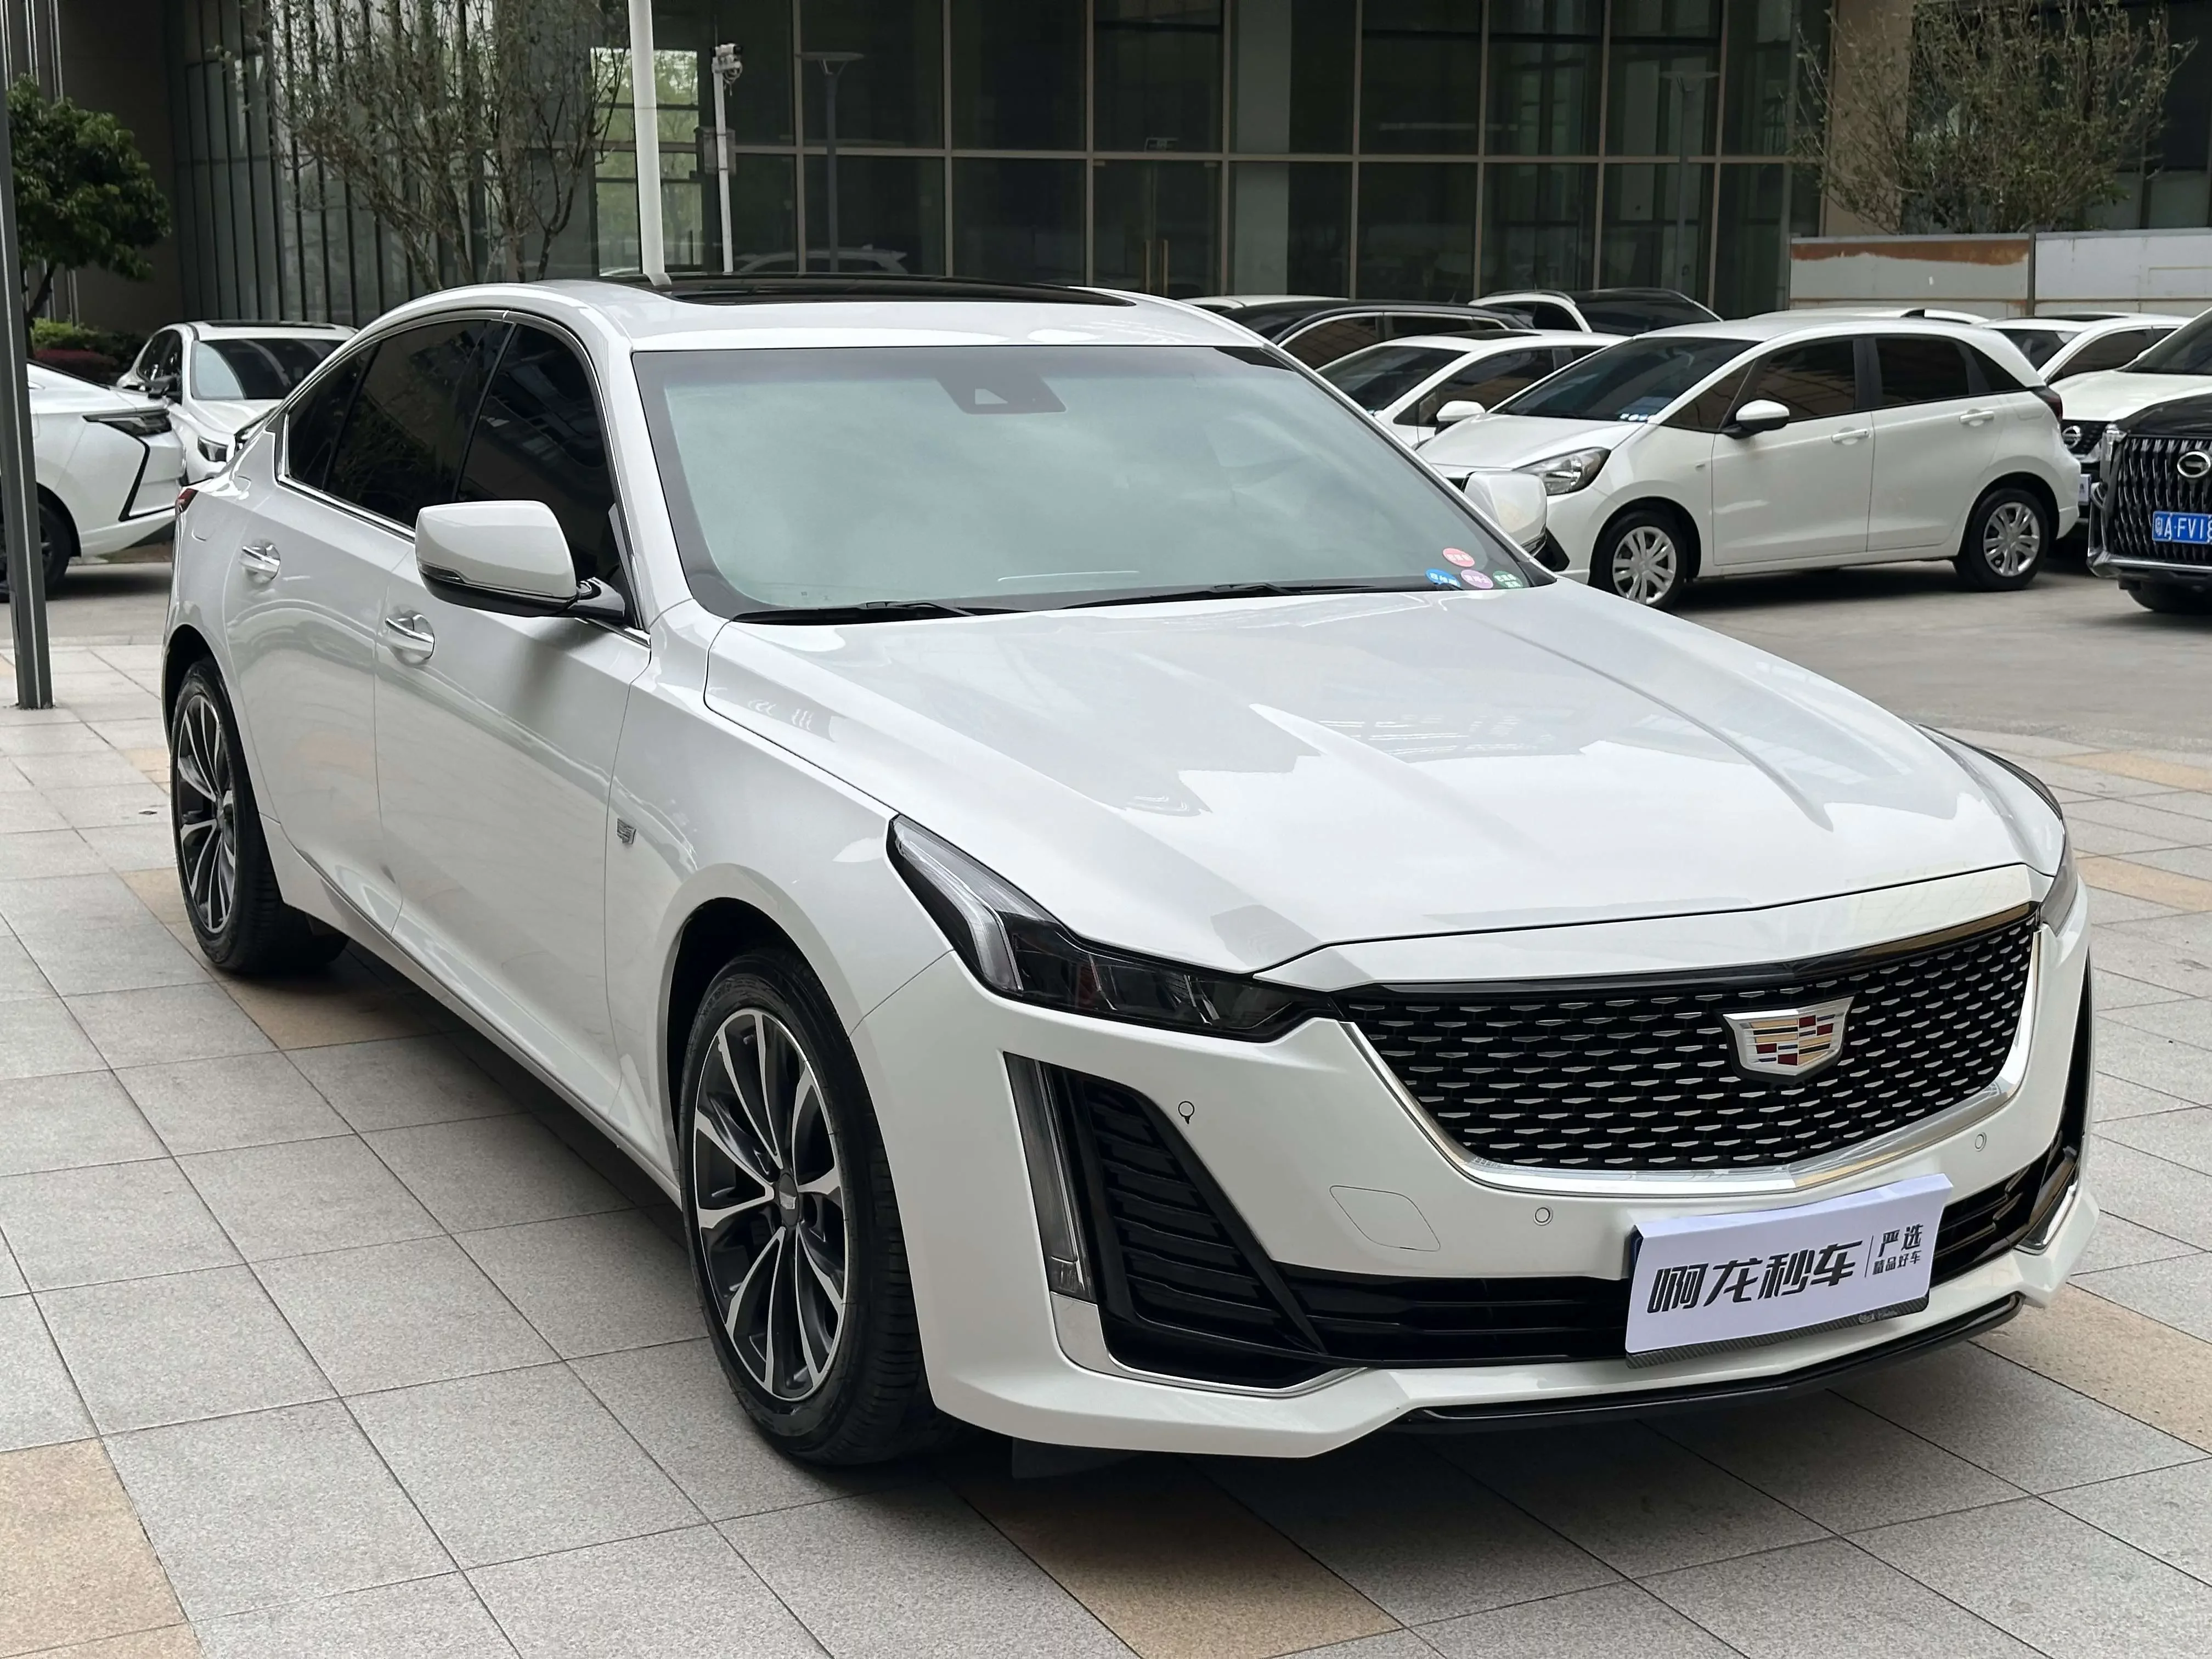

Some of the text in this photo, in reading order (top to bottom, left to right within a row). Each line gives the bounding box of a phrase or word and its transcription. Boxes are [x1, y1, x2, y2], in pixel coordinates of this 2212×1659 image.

[1878, 1224, 1924, 1258] 严选
[1647, 1240, 1863, 1314] 啊龙秒车
[1872, 1250, 1922, 1276] 精品好车
